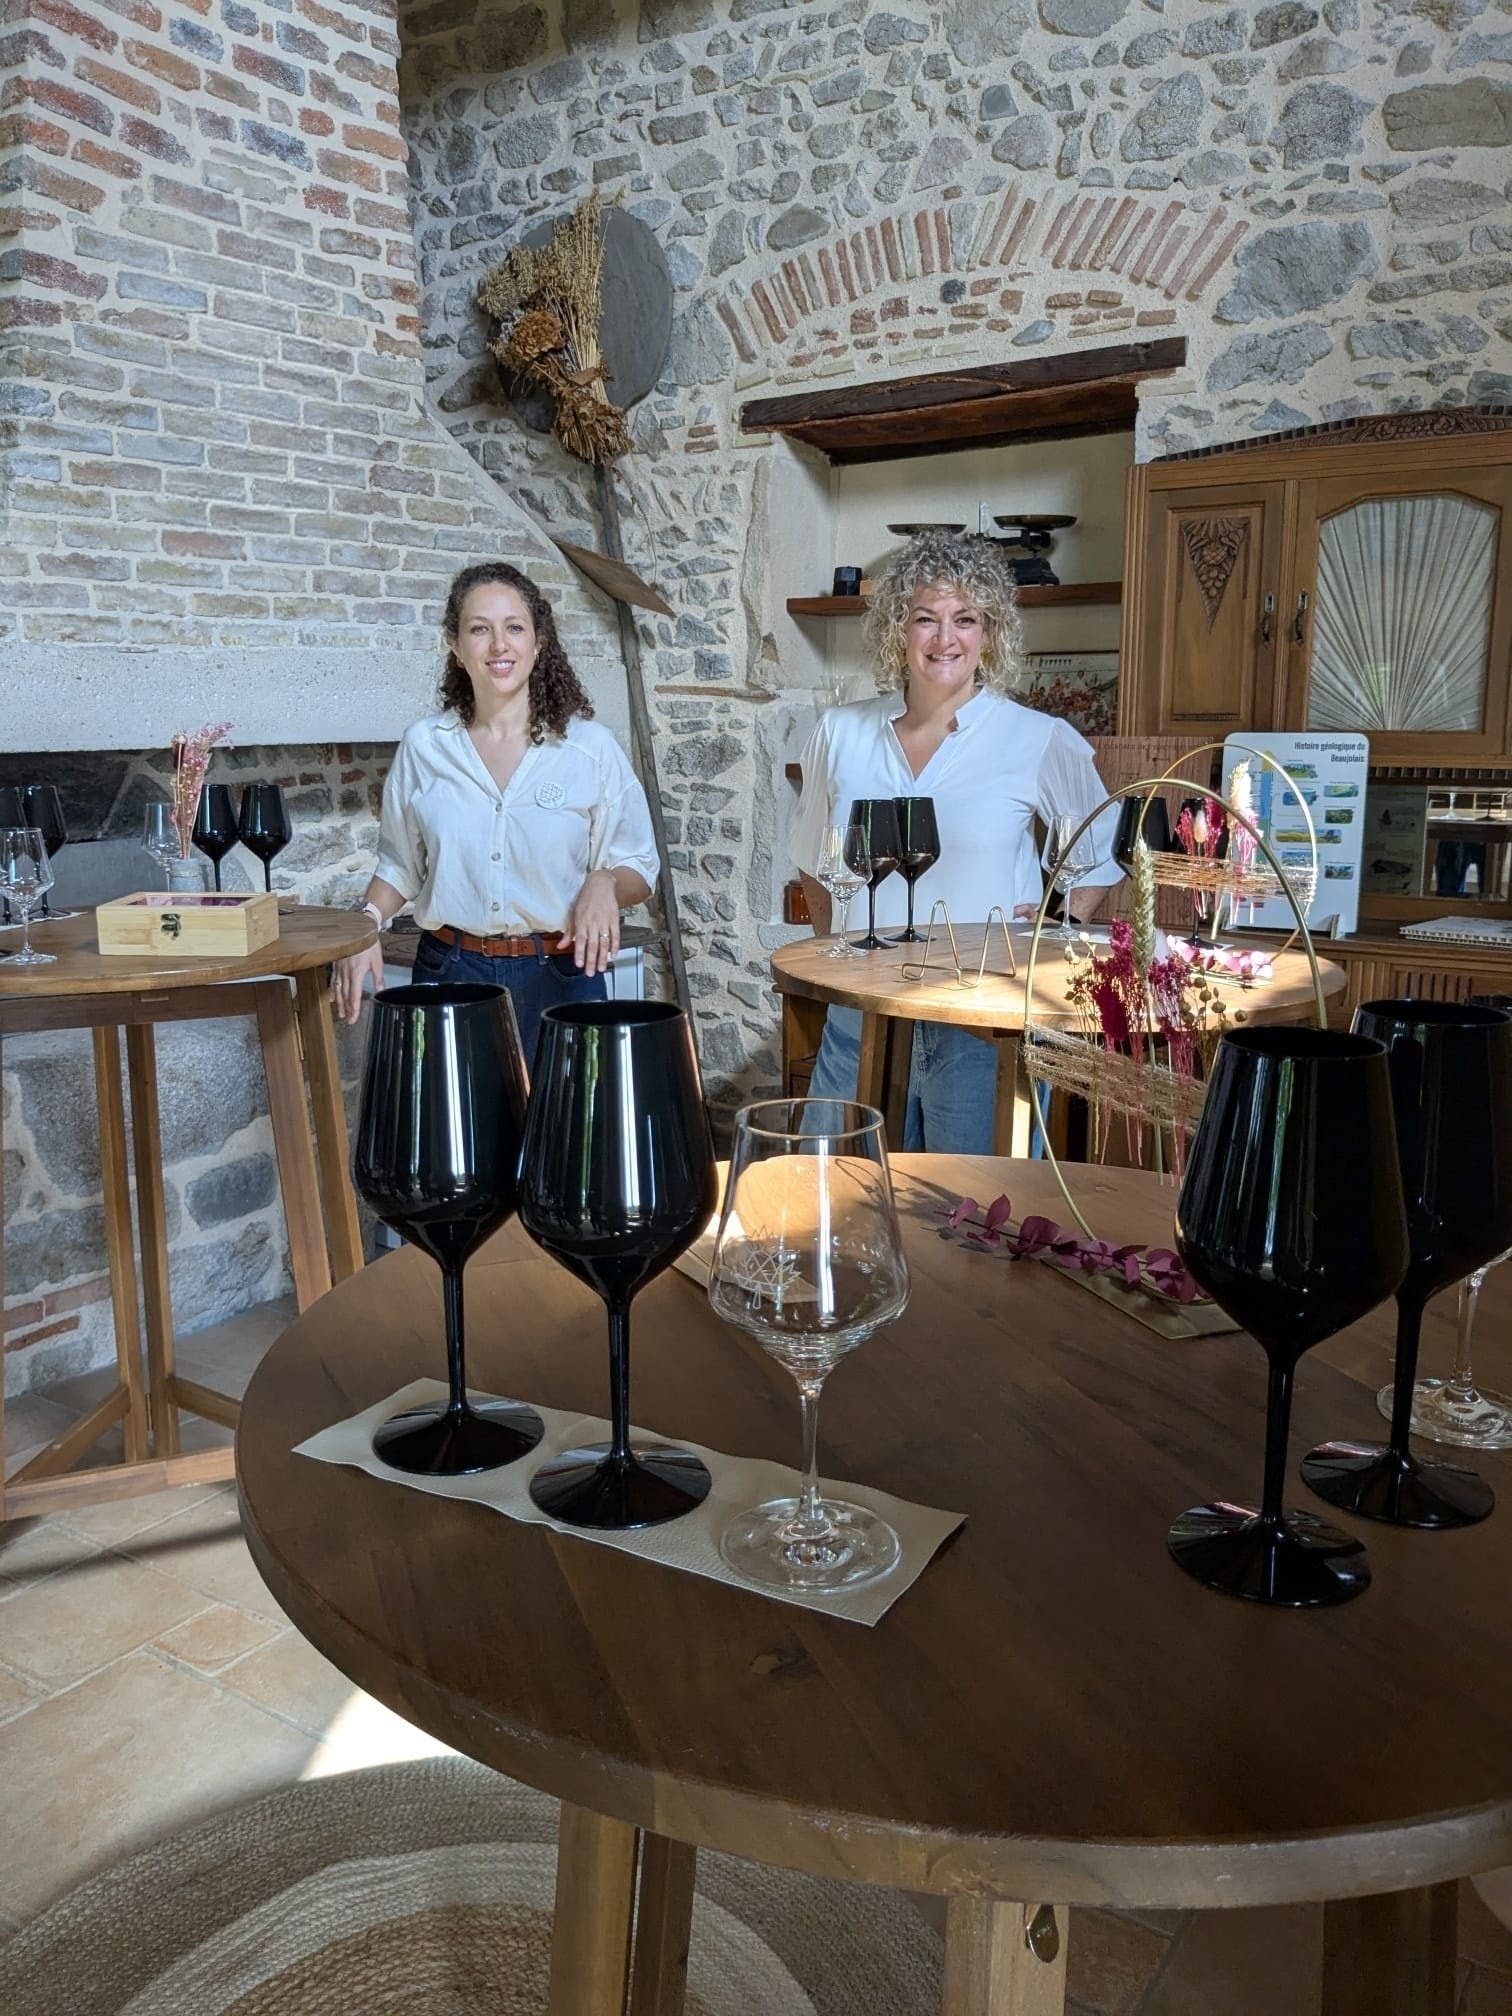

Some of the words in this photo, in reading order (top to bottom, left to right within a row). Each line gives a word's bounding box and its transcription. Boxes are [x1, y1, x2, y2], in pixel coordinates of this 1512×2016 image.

[1294, 741, 1319, 750] Histoire
[1320, 741, 1355, 751] géologique
[1357, 741, 1365, 750] du
[1331, 754, 1364, 763] Beaujolais
